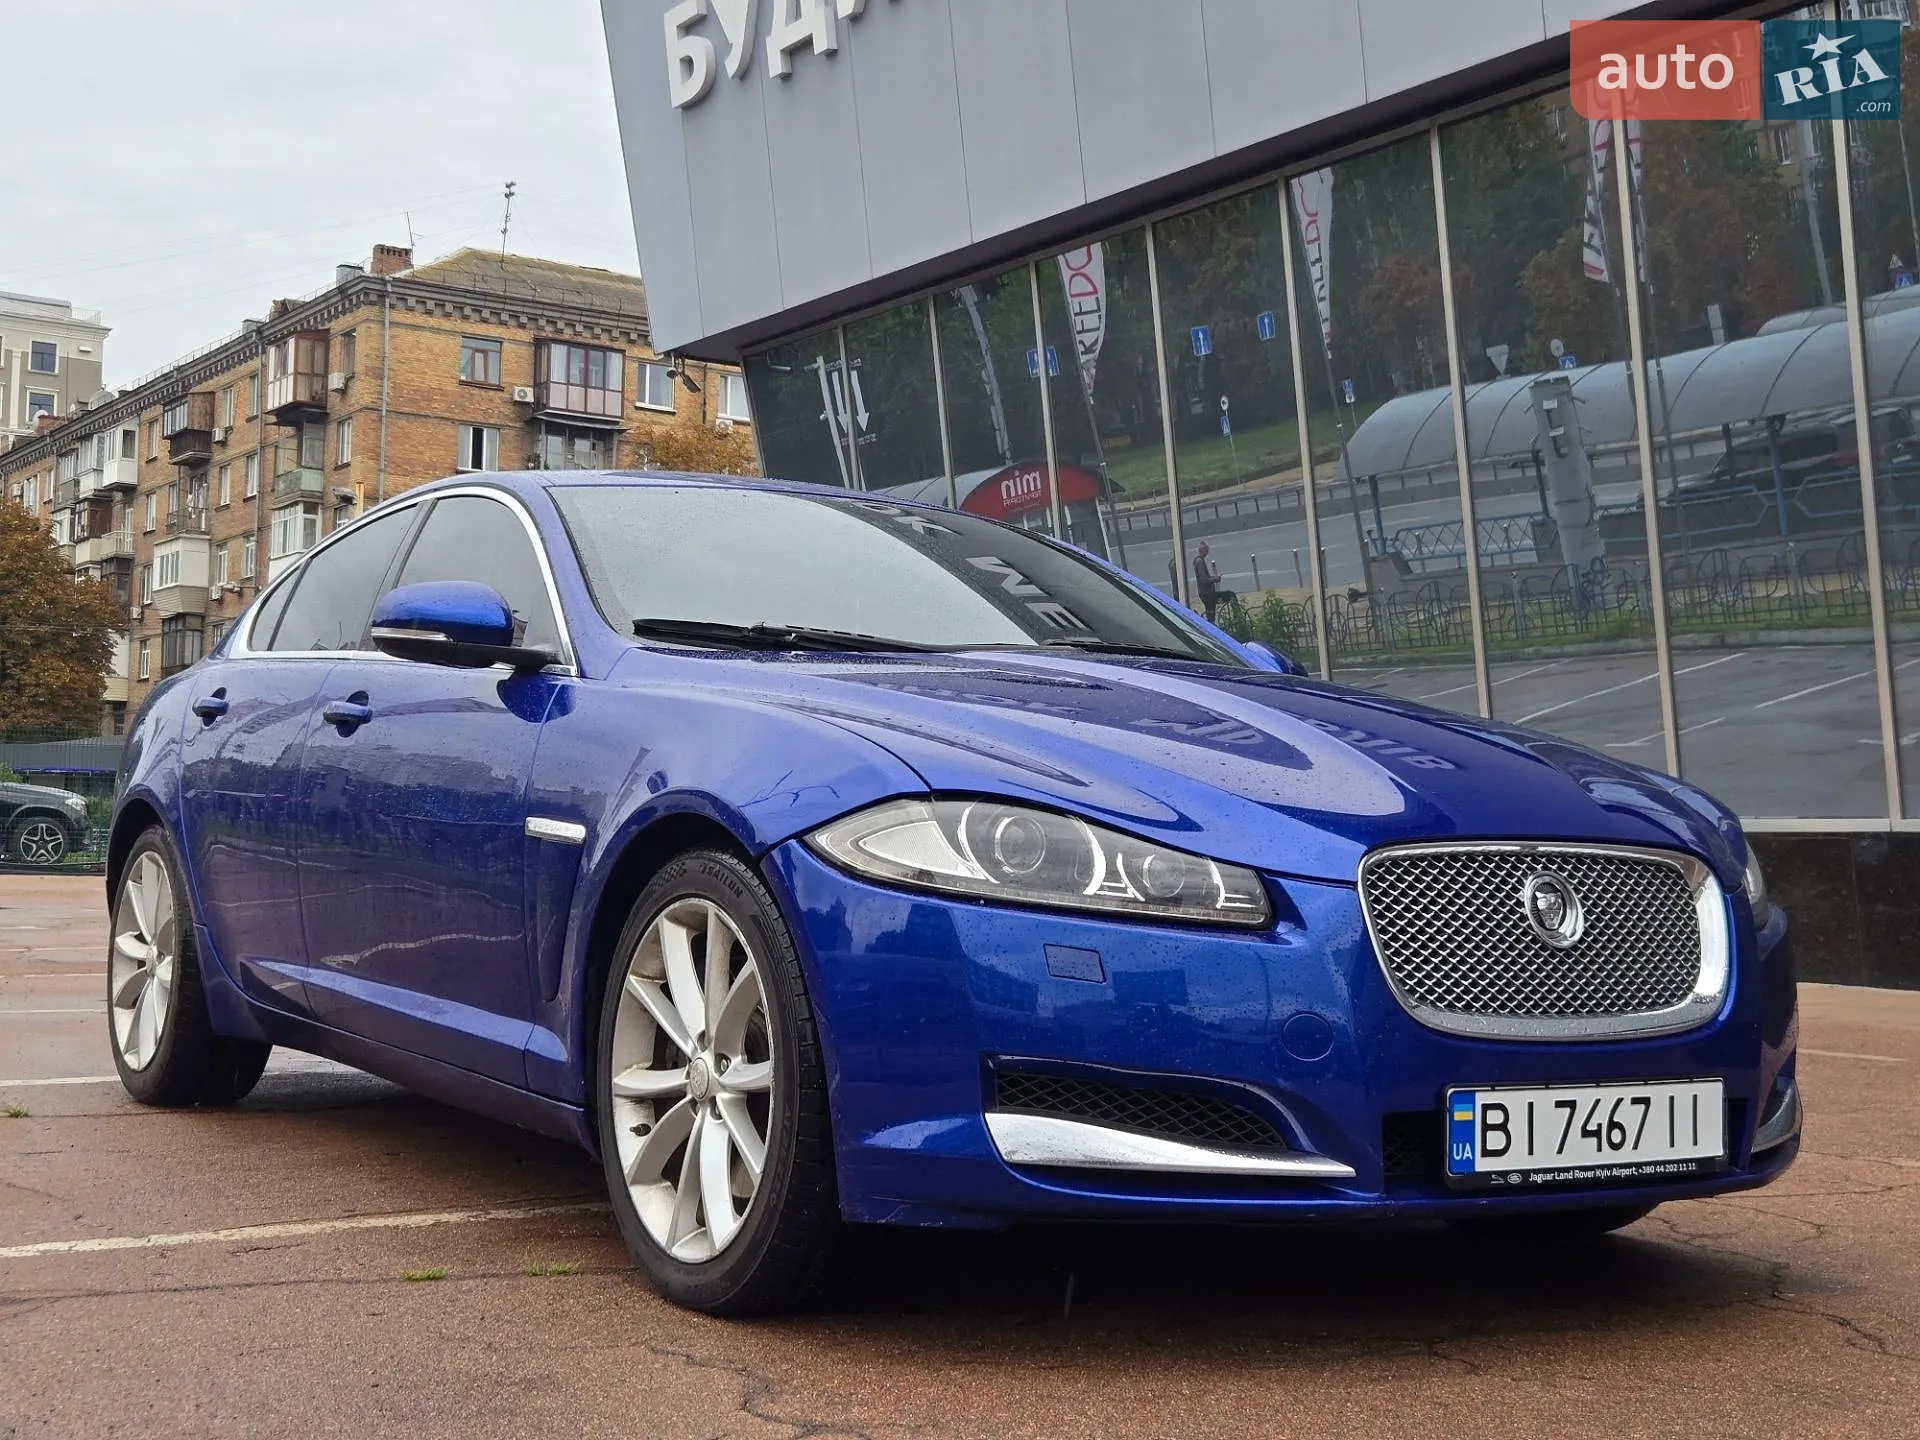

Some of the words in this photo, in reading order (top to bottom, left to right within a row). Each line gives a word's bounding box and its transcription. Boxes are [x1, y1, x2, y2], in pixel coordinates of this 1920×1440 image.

[664, 0, 866, 108] БУД
[1453, 1143, 1473, 1160] UA
[1528, 1172, 1554, 1184] Jaguar
[1555, 1170, 1573, 1180] Land
[1574, 1169, 1595, 1179] Rover
[1596, 1167, 1611, 1179] Kyiv
[1612, 1166, 1638, 1178] Airport,
[1638, 1165, 1655, 1174] +380
[1656, 1164, 1664, 1173] 44
[1665, 1163, 1678, 1172] 202
[1679, 1163, 1687, 1171] 11
[1688, 1162, 1696, 1170] 11
